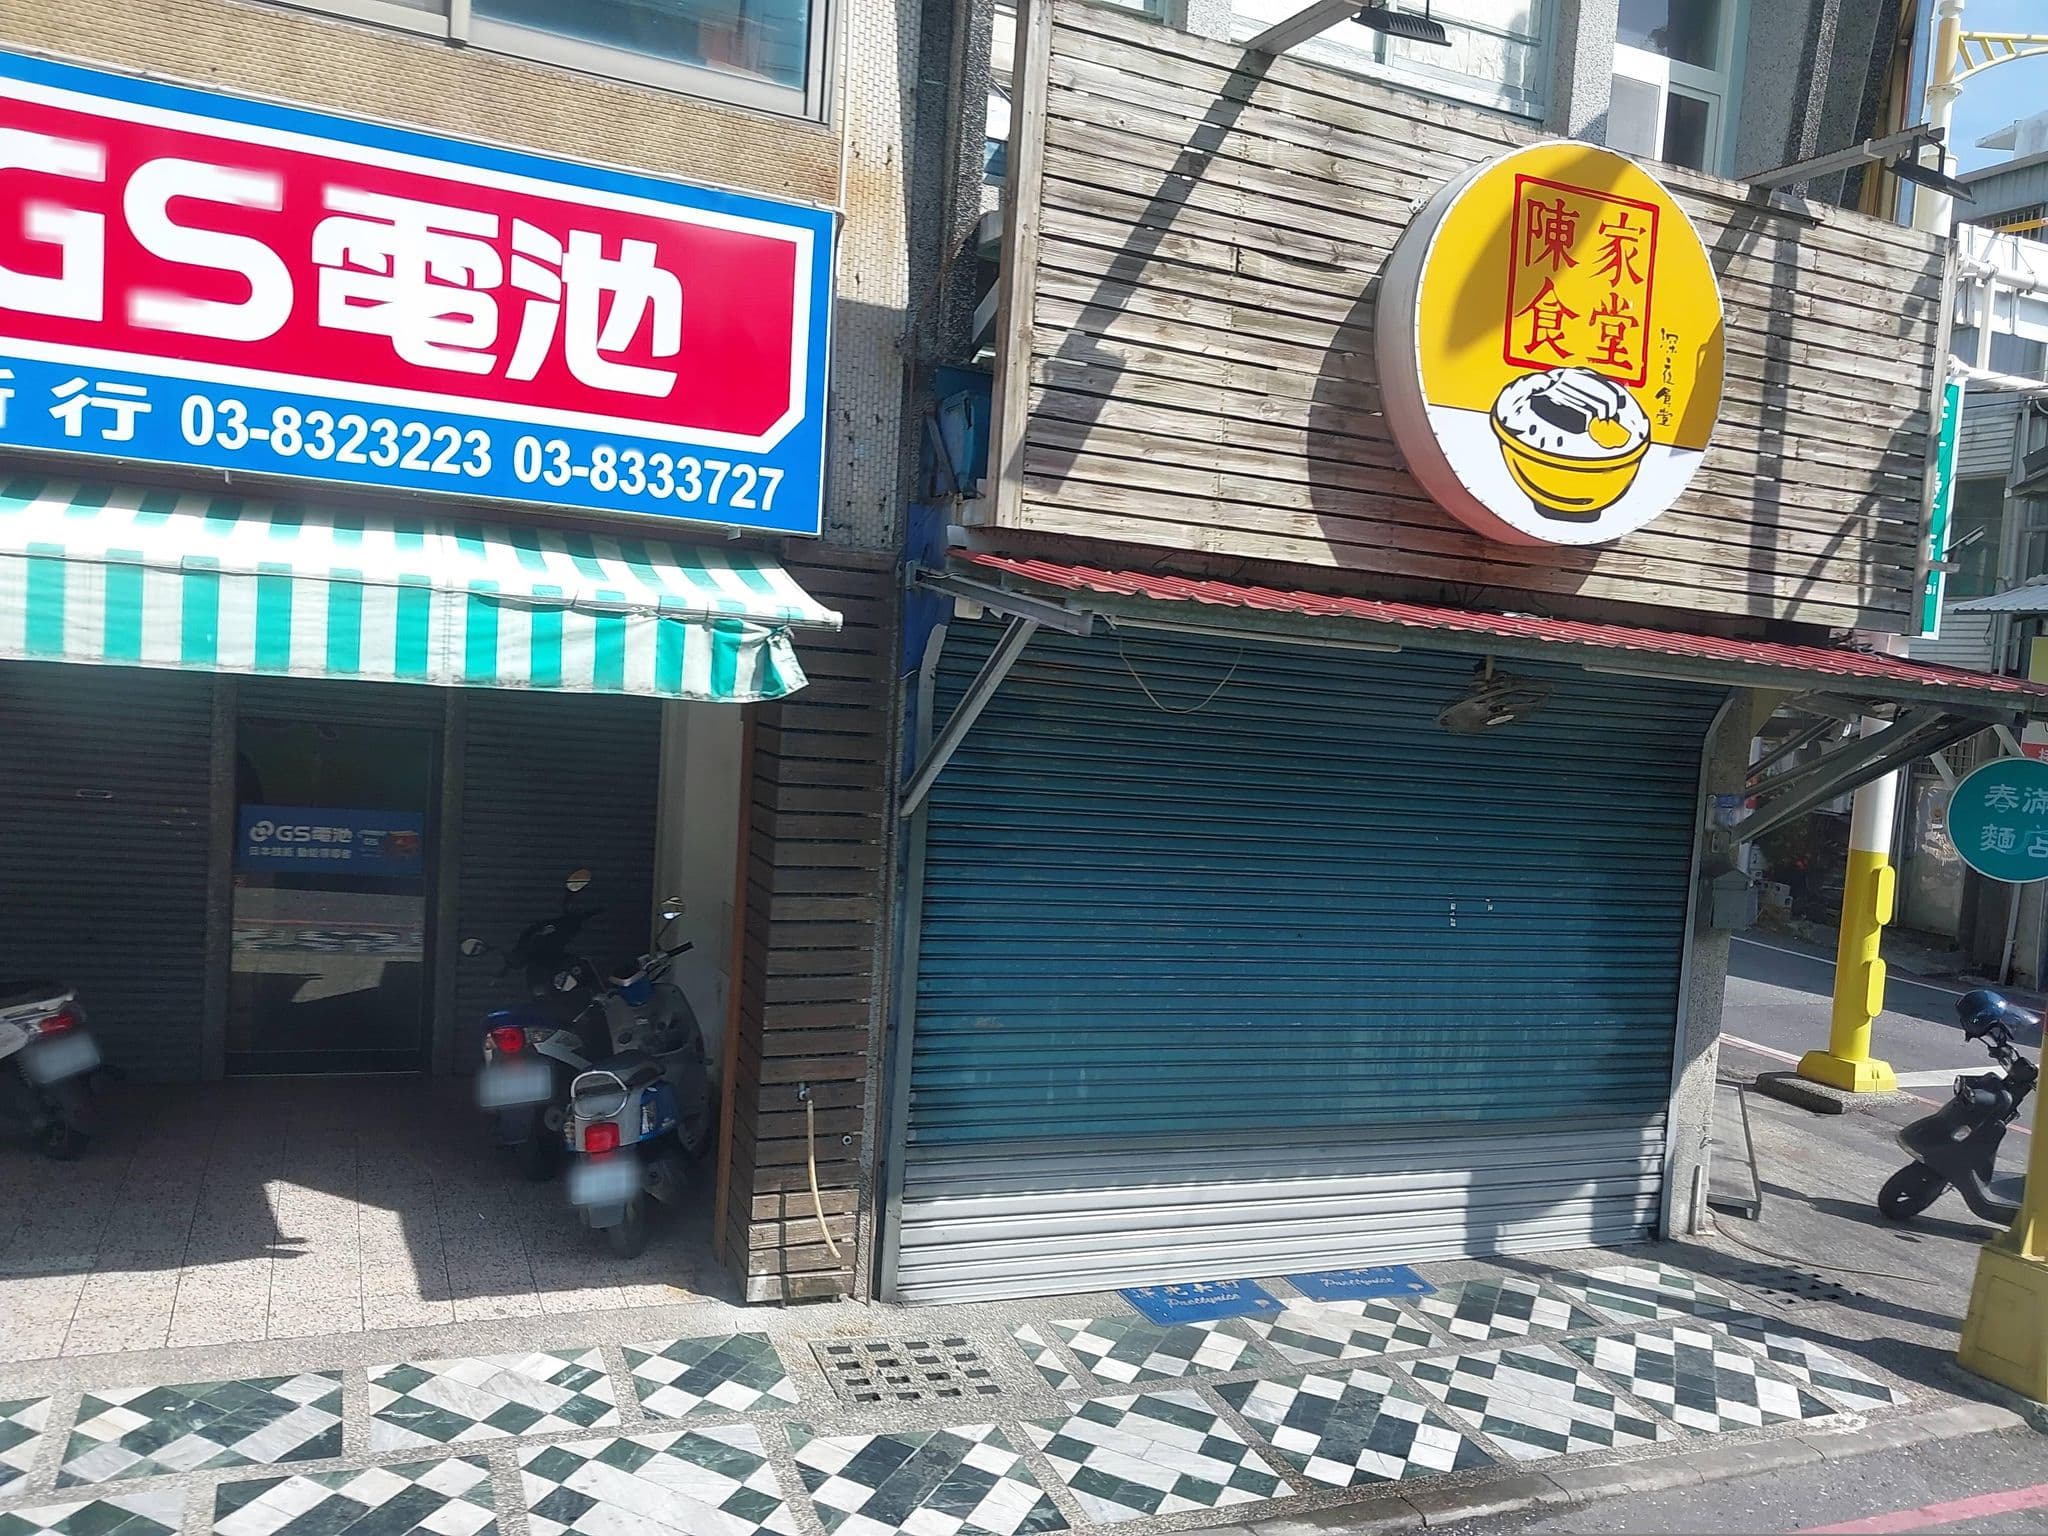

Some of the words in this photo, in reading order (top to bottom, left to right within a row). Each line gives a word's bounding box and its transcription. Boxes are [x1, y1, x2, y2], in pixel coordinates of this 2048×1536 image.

[0, 128, 684, 399] GS電池
[1524, 198, 1648, 288] 陳家
[1514, 277, 1641, 371] 食堂
[180, 394, 493, 479] 03-8323223
[514, 435, 785, 512] 03-8333727
